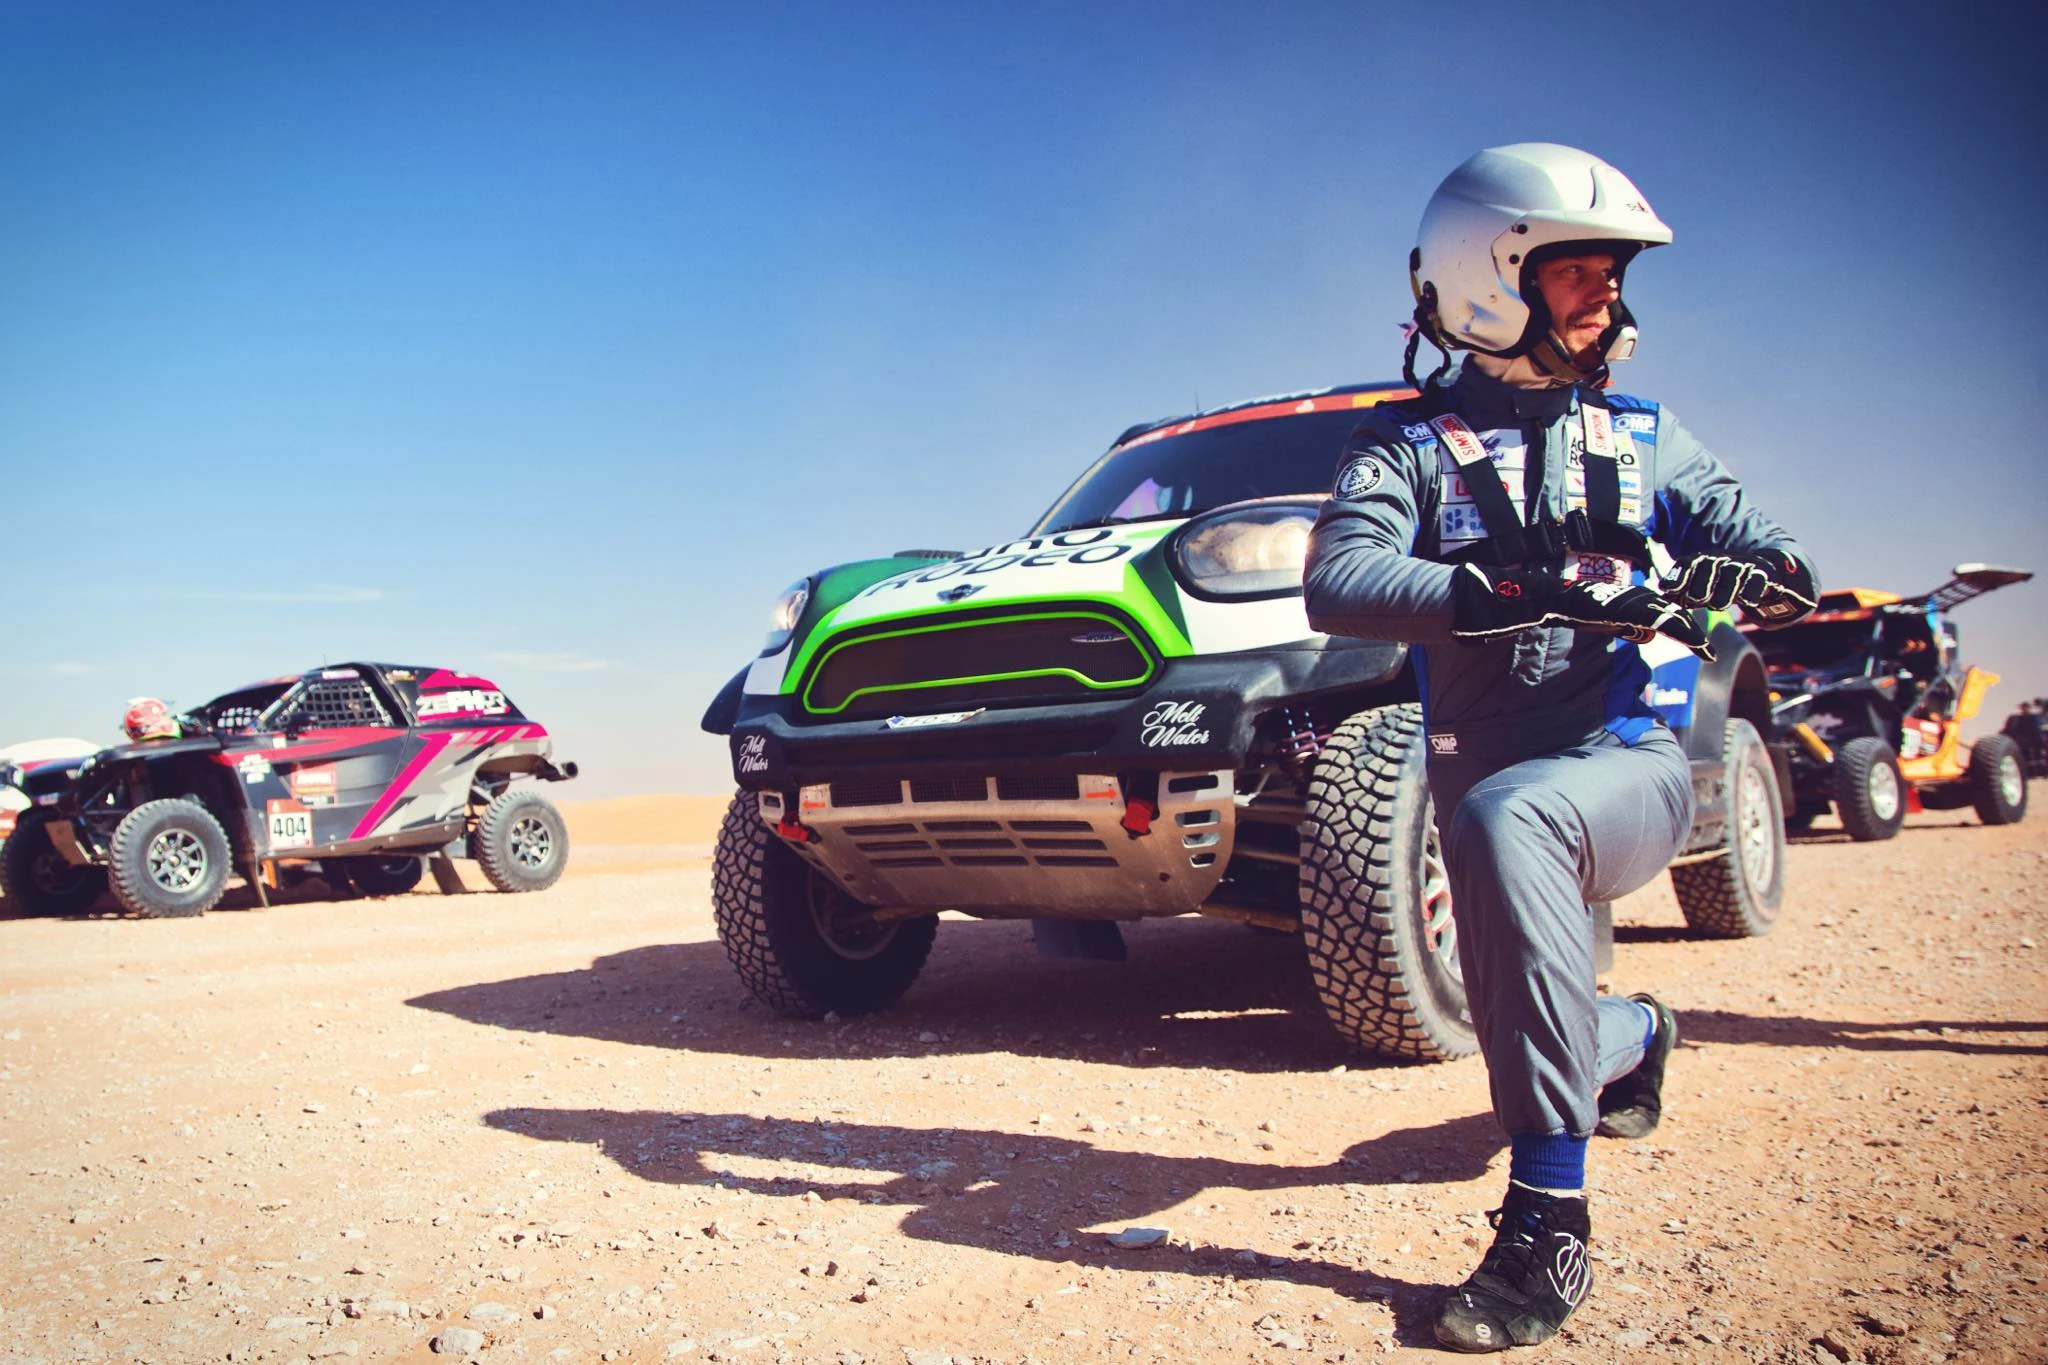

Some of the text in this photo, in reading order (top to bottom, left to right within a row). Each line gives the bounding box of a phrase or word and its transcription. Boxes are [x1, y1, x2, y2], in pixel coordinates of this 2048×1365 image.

[1403, 424, 1434, 439] OM
[1616, 417, 1655, 431] OMP
[1143, 701, 1206, 727] Melt
[1141, 722, 1210, 747] Water
[1431, 736, 1458, 751] OMP
[273, 817, 306, 837] 404
